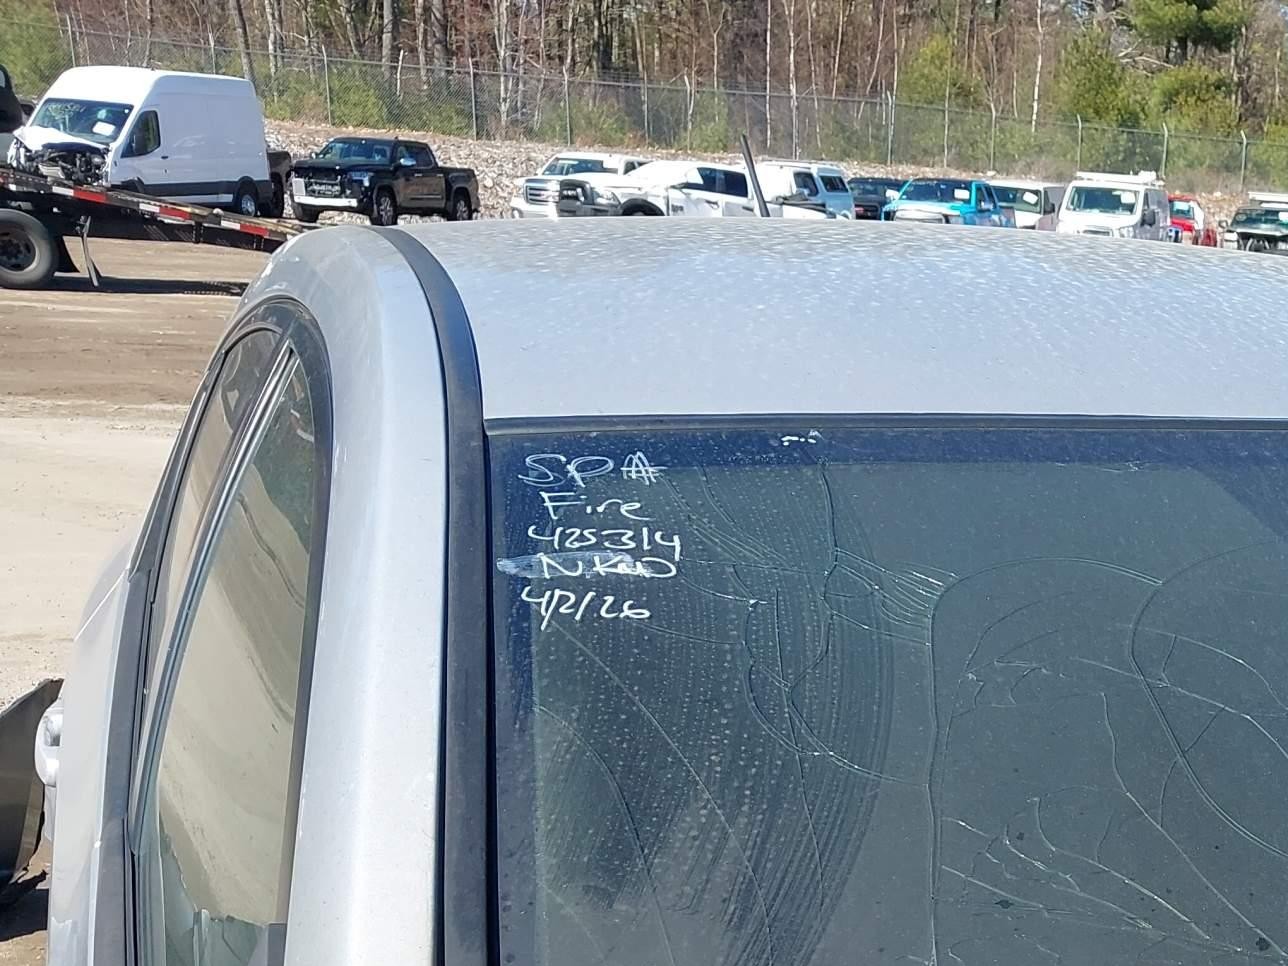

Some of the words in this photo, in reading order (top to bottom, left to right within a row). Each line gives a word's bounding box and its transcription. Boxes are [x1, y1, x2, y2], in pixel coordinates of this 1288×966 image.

[539, 491, 656, 521] Fire
[527, 525, 682, 562] 425314
[520, 585, 651, 631] 4/2/26
